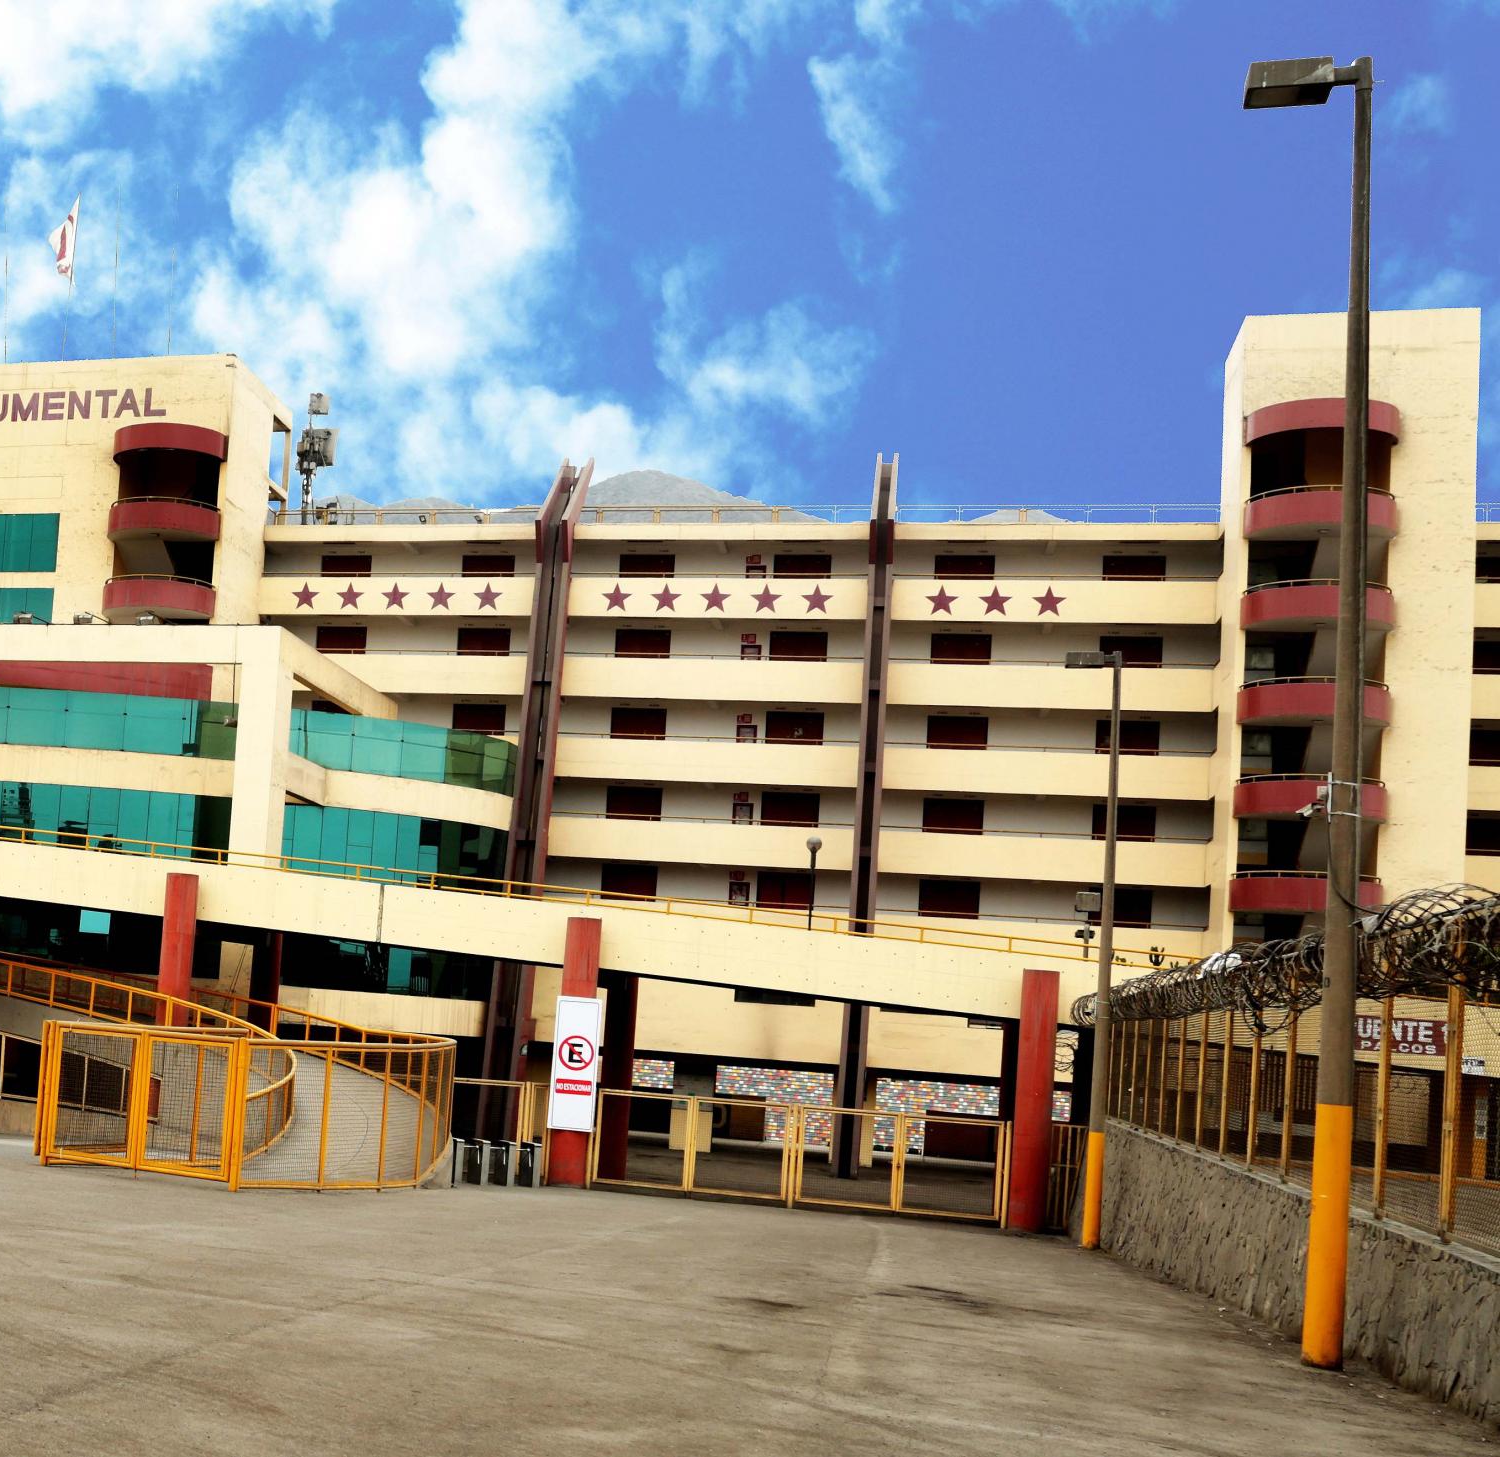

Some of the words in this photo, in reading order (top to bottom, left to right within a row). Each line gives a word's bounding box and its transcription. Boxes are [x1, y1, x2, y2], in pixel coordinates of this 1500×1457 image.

[1354, 1017, 1433, 1042] UENTE
[568, 1044, 583, 1063] E
[1361, 1040, 1436, 1054] PACOS
[564, 1083, 592, 1092] ESTACIONAR
